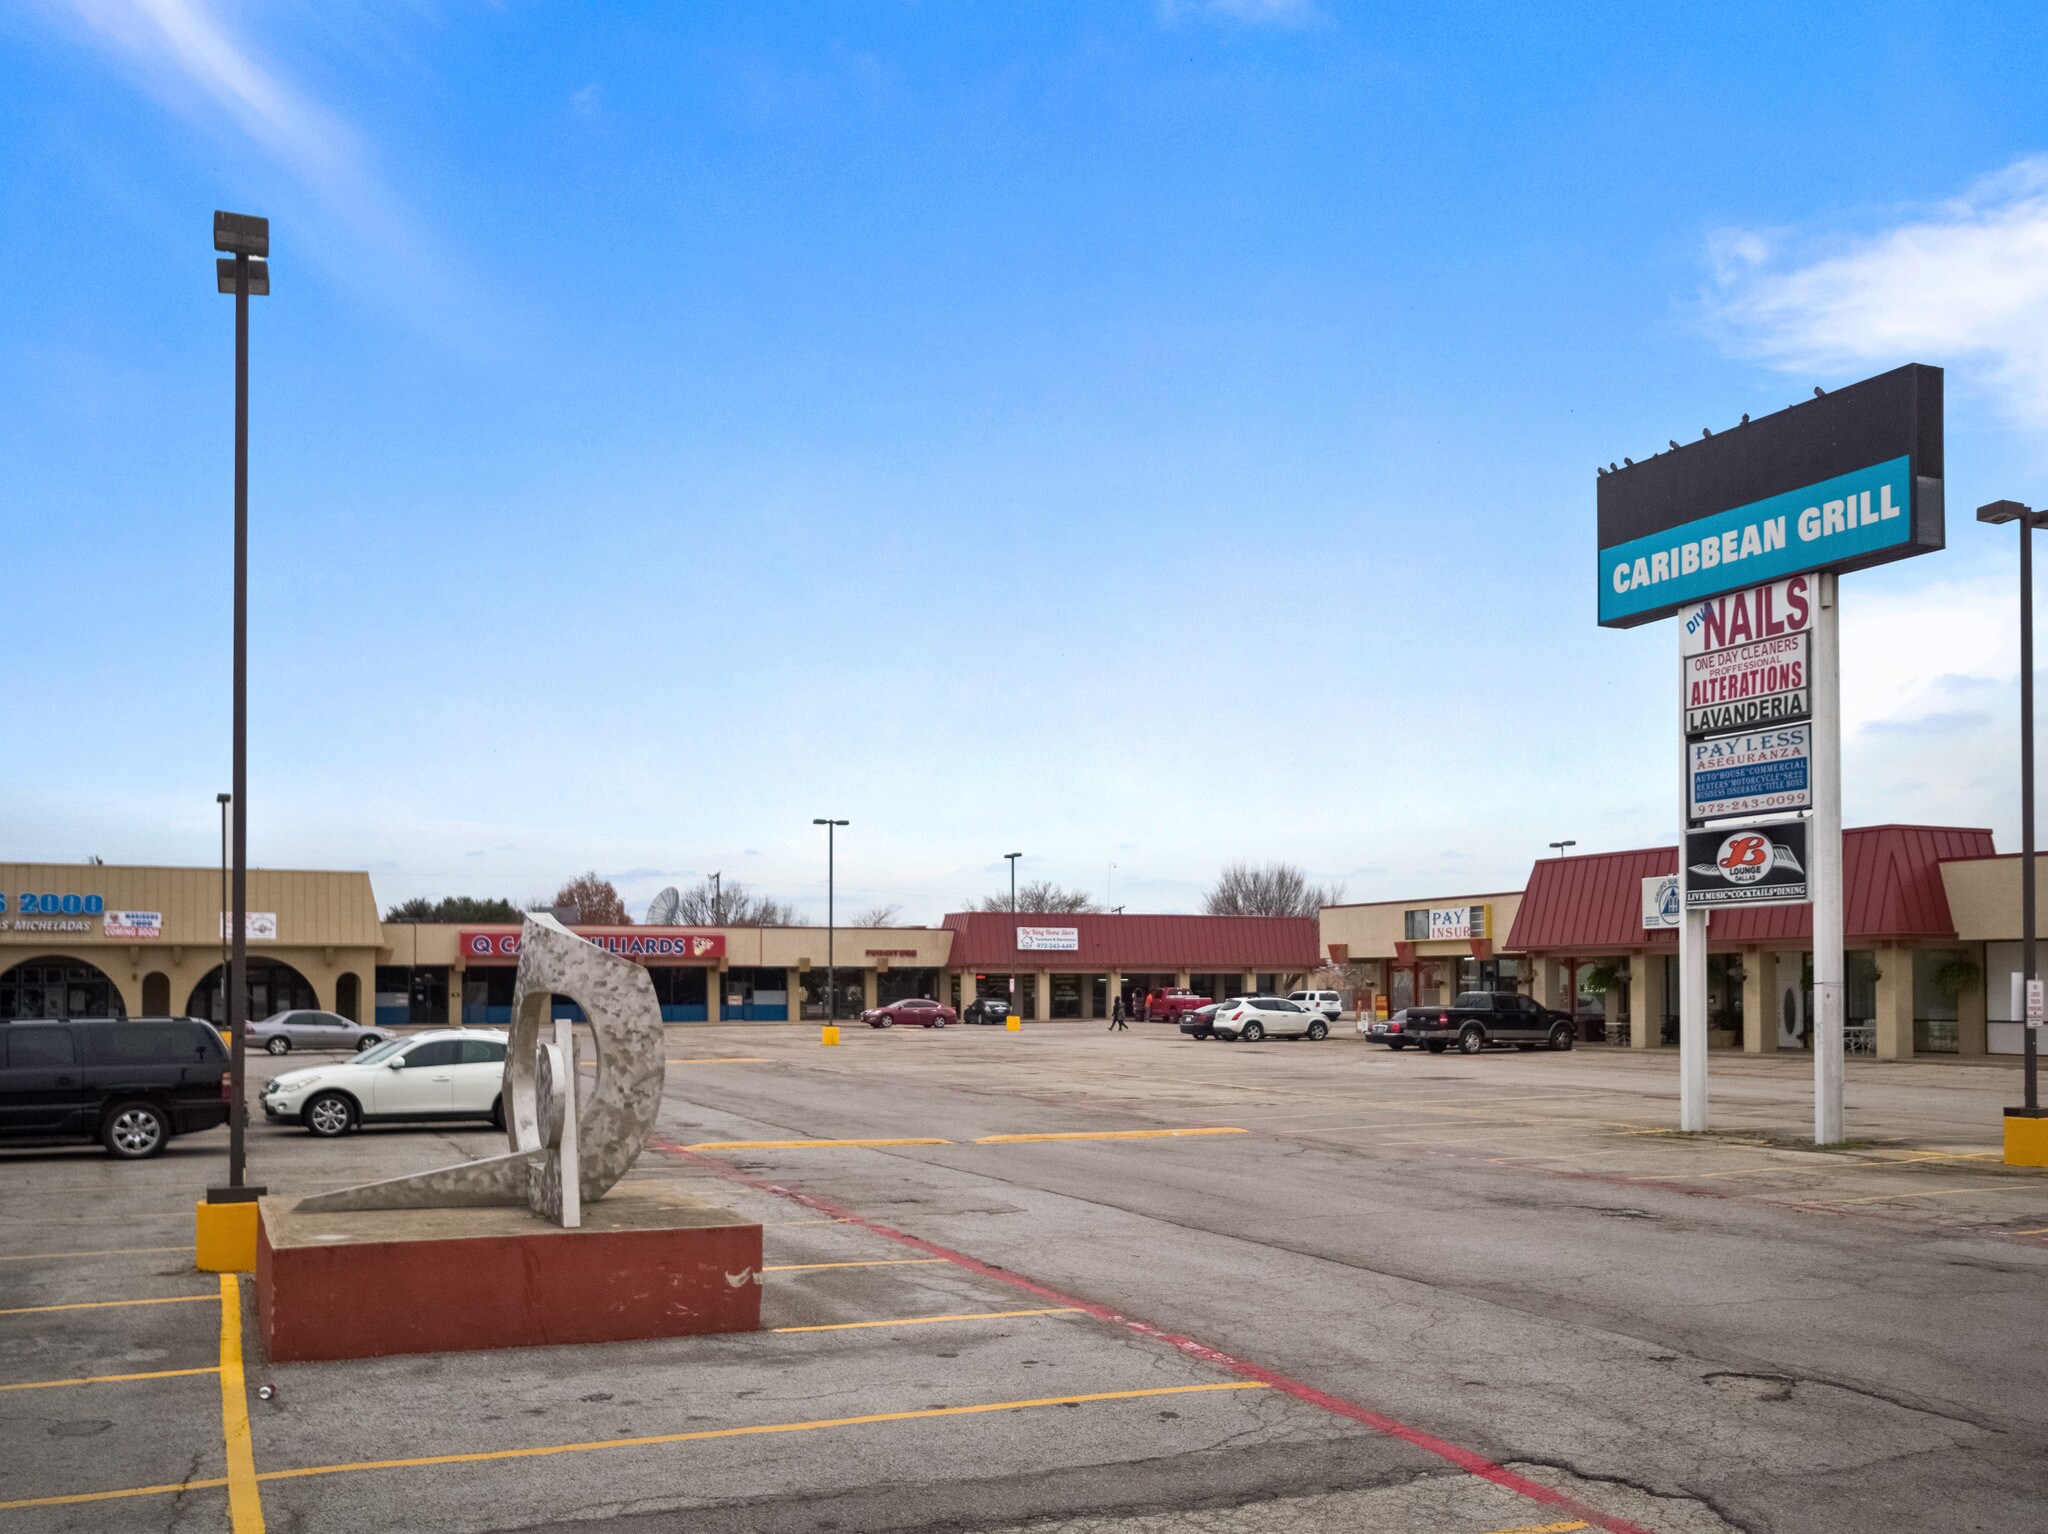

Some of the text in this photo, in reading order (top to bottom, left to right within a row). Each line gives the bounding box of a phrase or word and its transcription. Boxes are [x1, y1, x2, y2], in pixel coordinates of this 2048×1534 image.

[1612, 484, 1900, 593] CARIBBEAN GRILL
[1704, 576, 1809, 651] NAILS
[1695, 637, 1799, 671] ONE DAY CLEANERS
[1709, 655, 1782, 677] PROFFESSIONAL
[1691, 661, 1802, 706] ALTERATIONS
[1690, 693, 1803, 731] LAVANDERIA
[1696, 747, 1802, 770] ASEGURANZA
[1698, 793, 1805, 815] 972-243-0099
[1729, 865, 1762, 876] LOUNGE
[19, 892, 104, 914] 2000
[1687, 893, 1704, 901] LIVE
[14, 920, 91, 932] MICHELADAS
[1432, 908, 1465, 925] PAY
[105, 926, 159, 937] COMING SOON
[472, 935, 493, 955] Q
[583, 936, 686, 956] ILLIARDS
